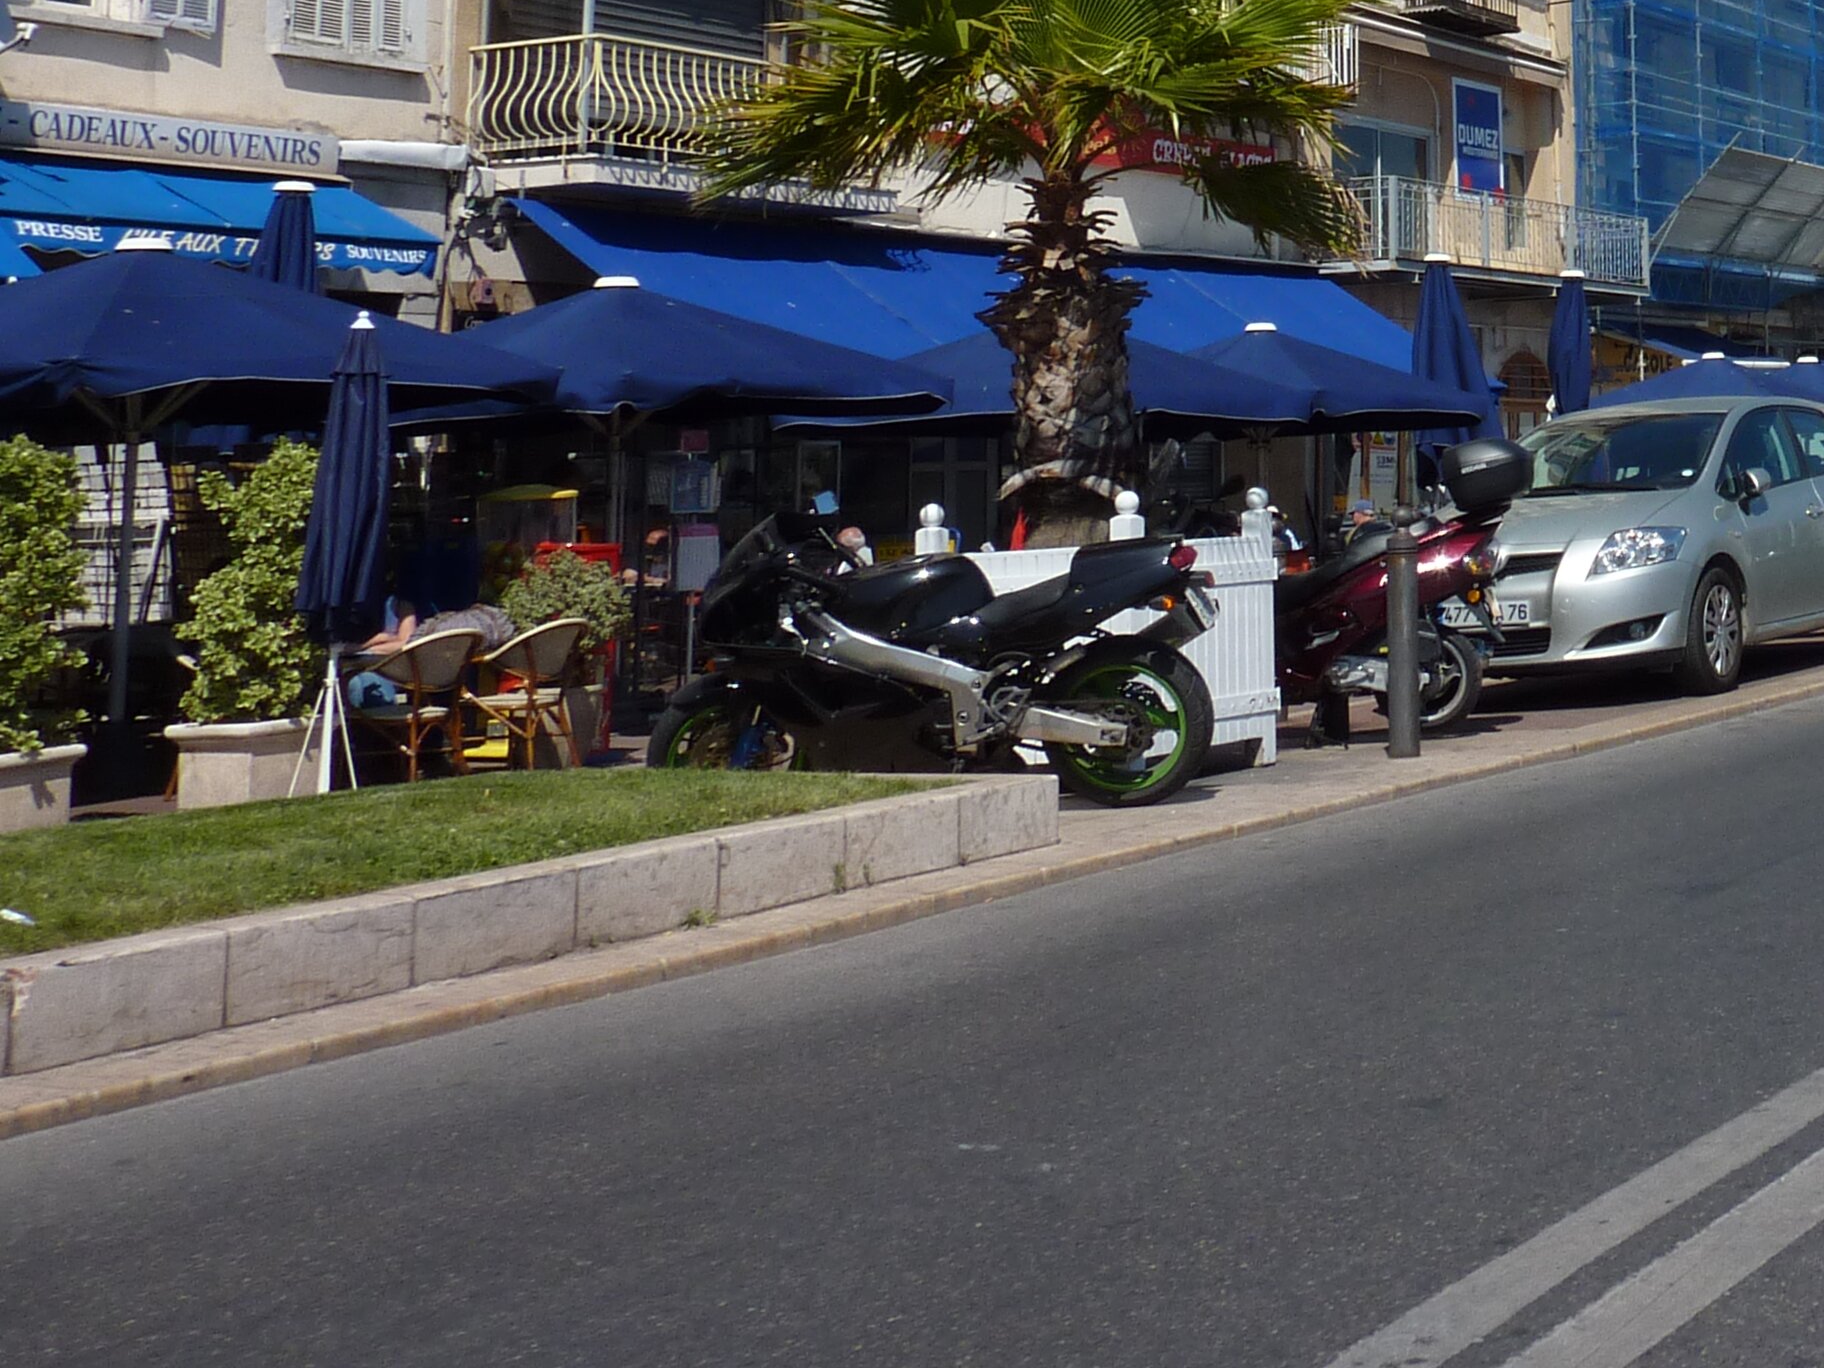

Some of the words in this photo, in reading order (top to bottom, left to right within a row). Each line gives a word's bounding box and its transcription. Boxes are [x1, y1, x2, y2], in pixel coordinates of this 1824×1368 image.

[30, 110, 157, 150] CADEAUX
[174, 126, 321, 166] SOUVENIRS
[1458, 123, 1498, 149] DUMEZ
[14, 220, 104, 243] PRESSE
[176, 232, 226, 254] AUX
[346, 244, 427, 264] SOUVENIRS
[1508, 603, 1528, 621] 76
